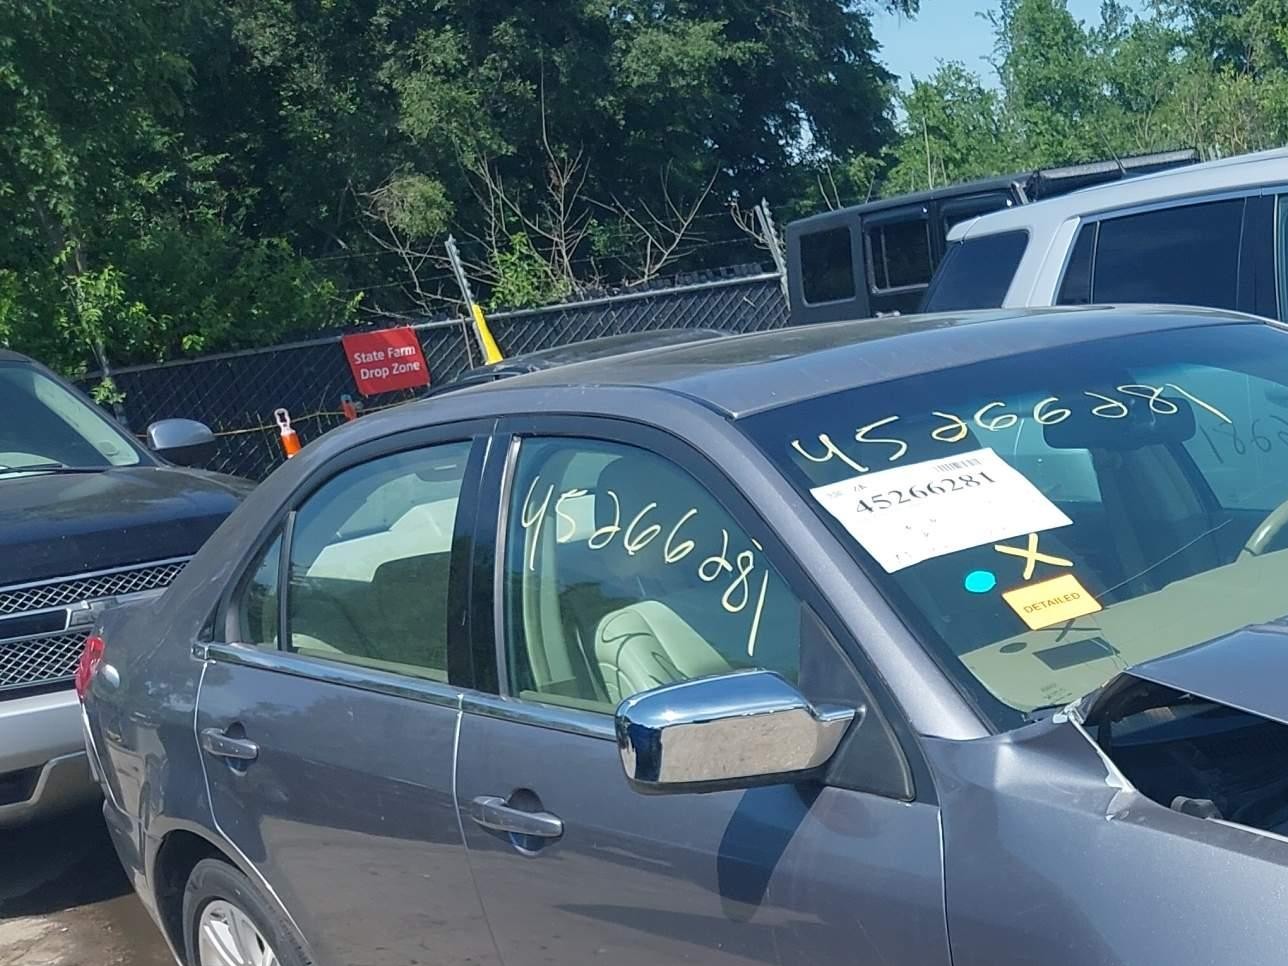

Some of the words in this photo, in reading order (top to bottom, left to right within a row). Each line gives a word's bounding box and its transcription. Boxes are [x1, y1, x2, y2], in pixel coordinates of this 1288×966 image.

[353, 350, 385, 365] State
[387, 345, 416, 358] Farm
[360, 366, 390, 380] Drop
[391, 361, 420, 375] Zone
[791, 384, 1232, 472] 45266281
[856, 471, 996, 514] 45266281
[521, 476, 769, 656] 45266281
[1023, 592, 1081, 614] DETAILED
